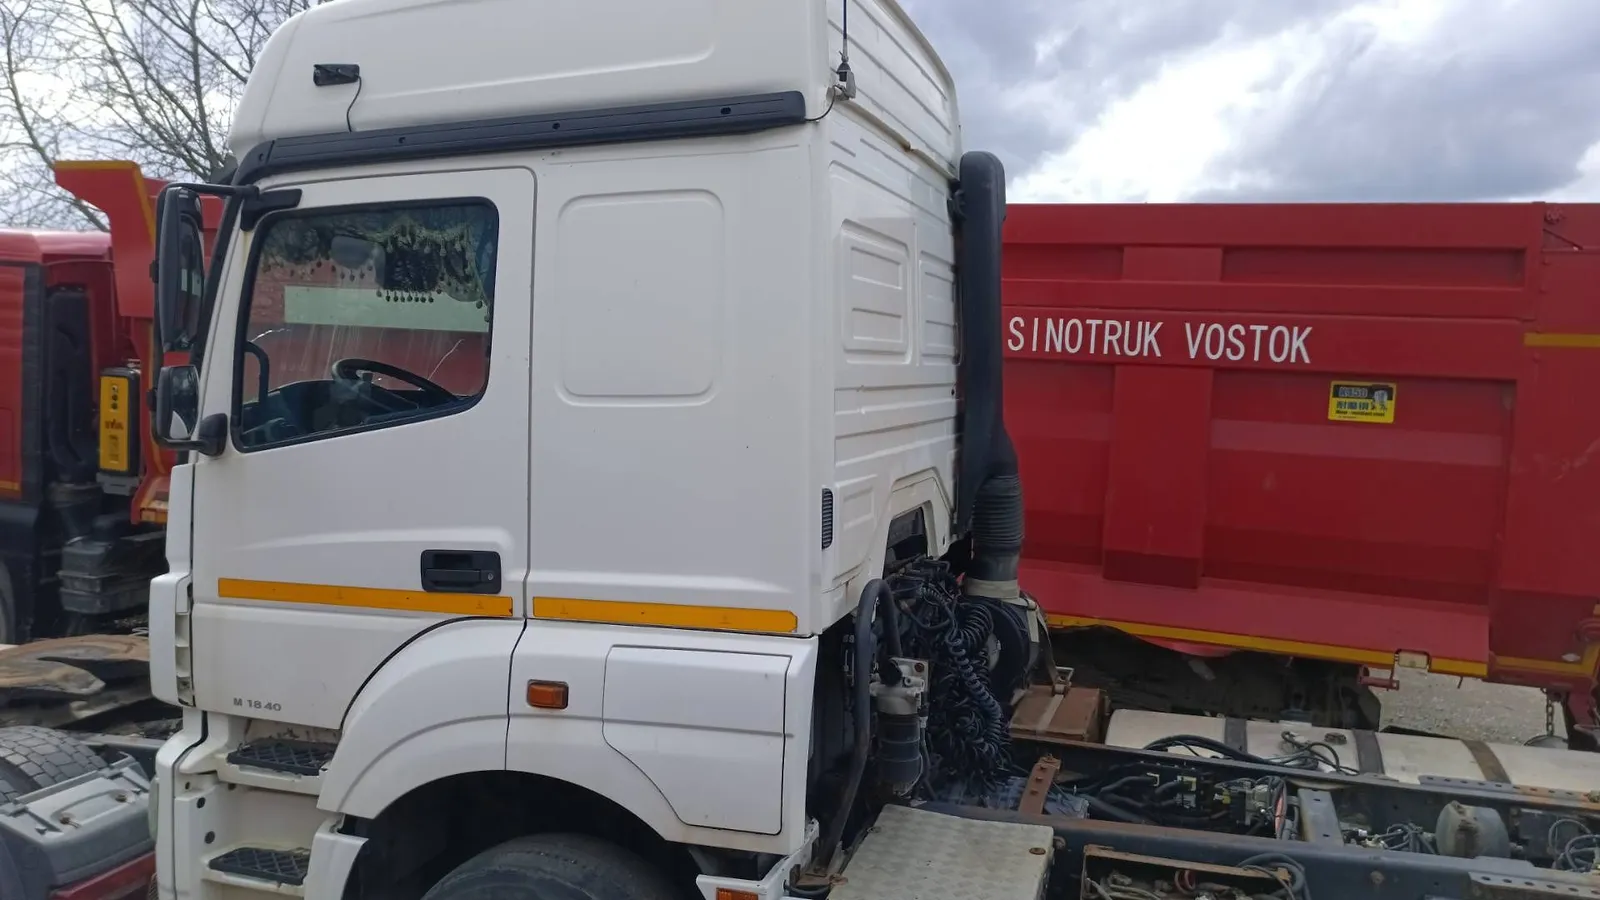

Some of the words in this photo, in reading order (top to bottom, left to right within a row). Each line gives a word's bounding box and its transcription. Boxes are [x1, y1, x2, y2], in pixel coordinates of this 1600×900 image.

[1007, 316, 1163, 357] SINOTRUK
[1184, 322, 1313, 364] VOSTOK
[233, 697, 243, 706] M
